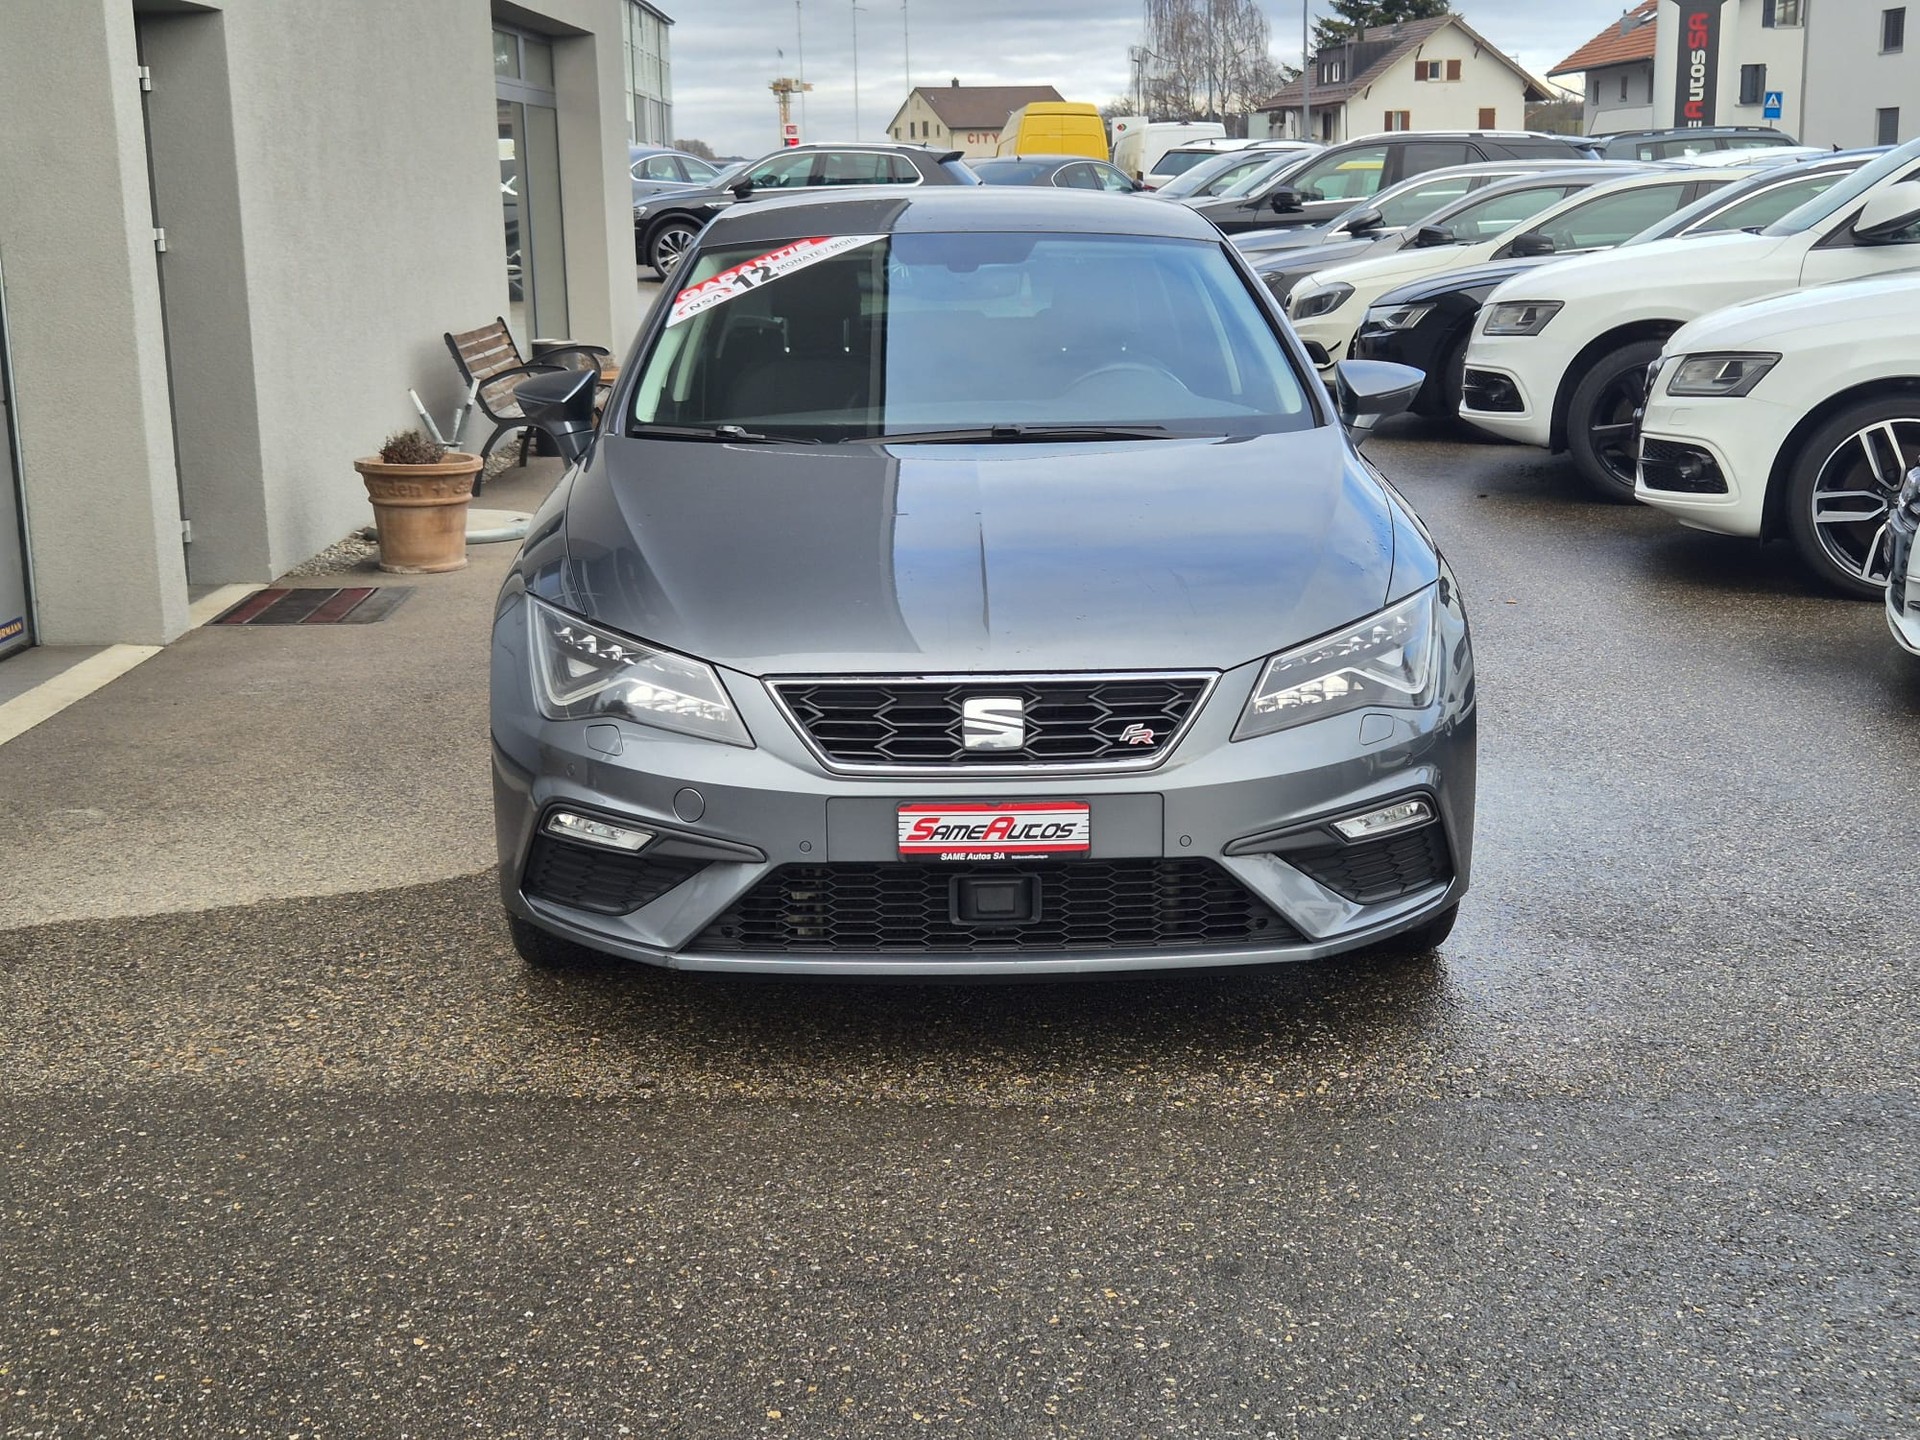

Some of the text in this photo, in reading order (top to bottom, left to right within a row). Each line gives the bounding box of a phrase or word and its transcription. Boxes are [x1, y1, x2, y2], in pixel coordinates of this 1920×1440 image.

[967, 132, 1000, 144] CITY
[732, 266, 780, 289] 12
[777, 249, 822, 272] MONATE
[831, 237, 860, 250] MOIS
[689, 293, 722, 311] NSA
[1119, 723, 1155, 745] FR
[940, 852, 966, 861] SAME
[967, 852, 991, 861] Autos
[993, 852, 1005, 860] SA
